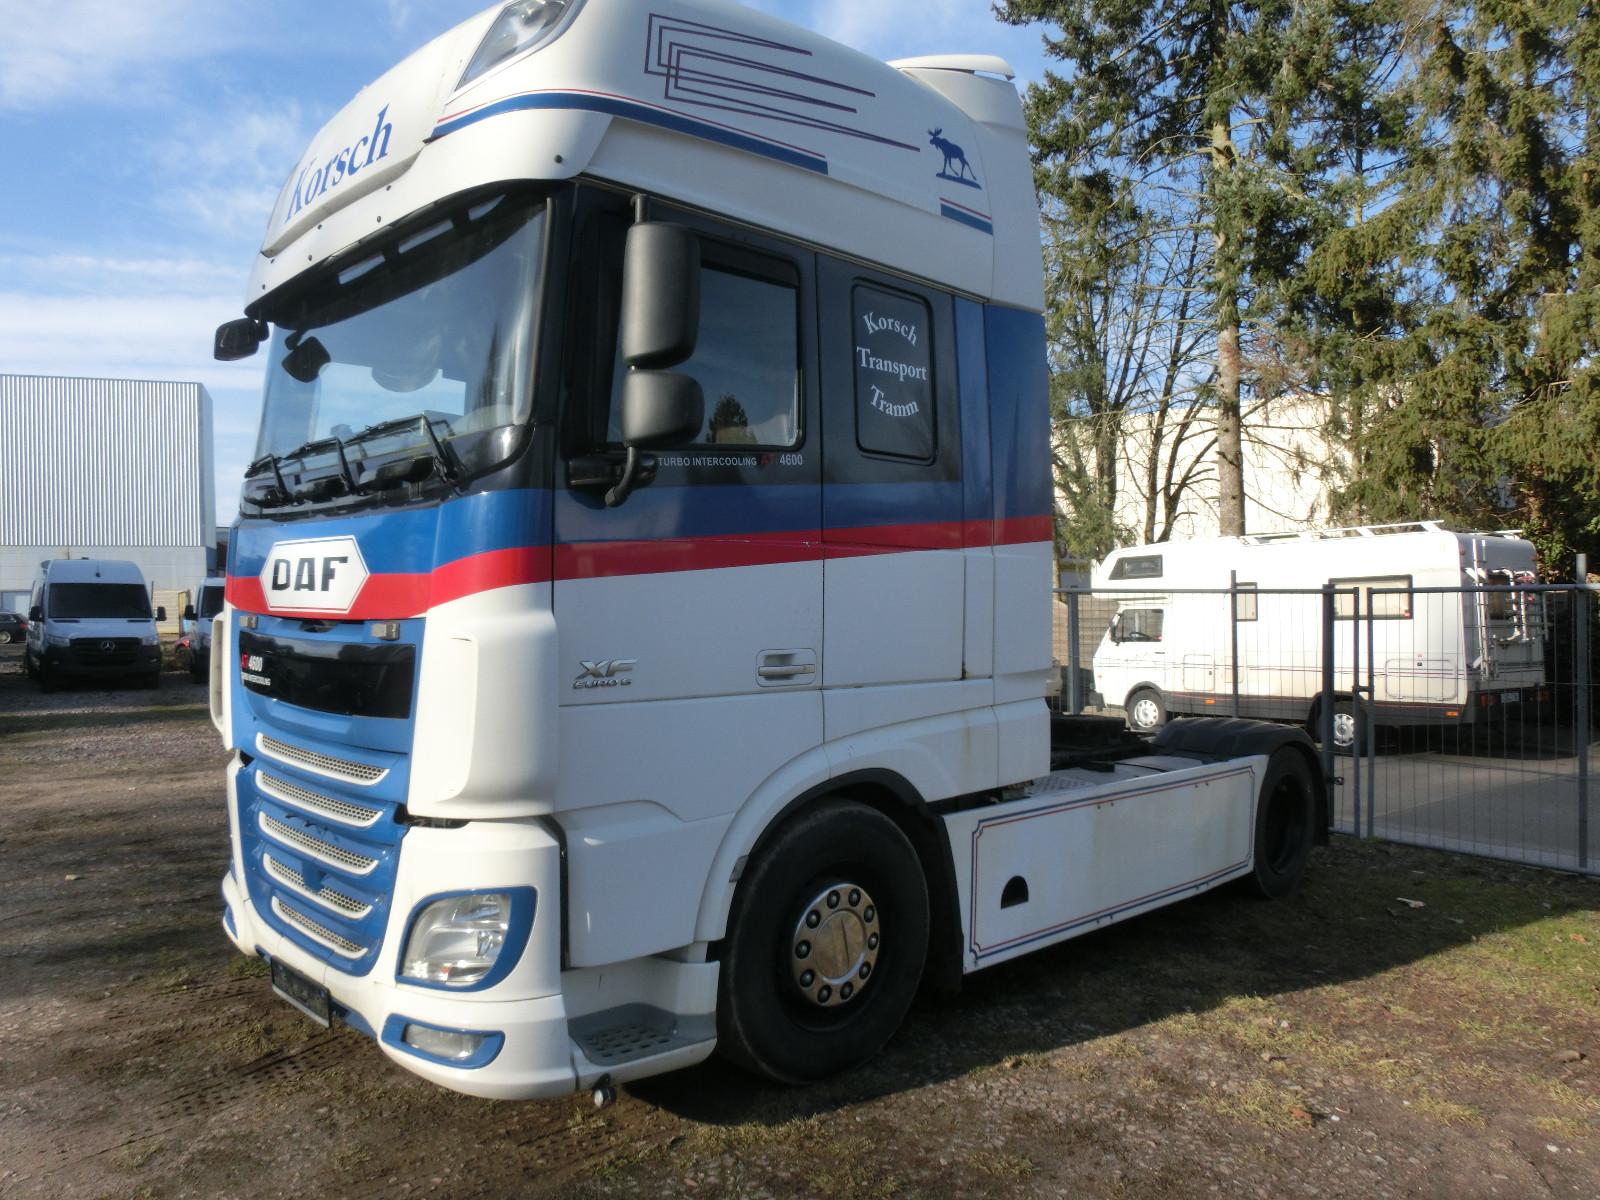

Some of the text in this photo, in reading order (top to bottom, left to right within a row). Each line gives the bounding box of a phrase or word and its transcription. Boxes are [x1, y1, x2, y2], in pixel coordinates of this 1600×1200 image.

[285, 103, 392, 224] Korsch
[863, 311, 917, 347] Korsch
[856, 346, 927, 381] Transport
[870, 384, 919, 417] Tramm
[658, 457, 690, 466] TURBO
[692, 457, 757, 466] INTERCOOLING
[779, 453, 803, 466] 4600
[271, 556, 348, 592] DAF
[575, 659, 637, 679] XF
